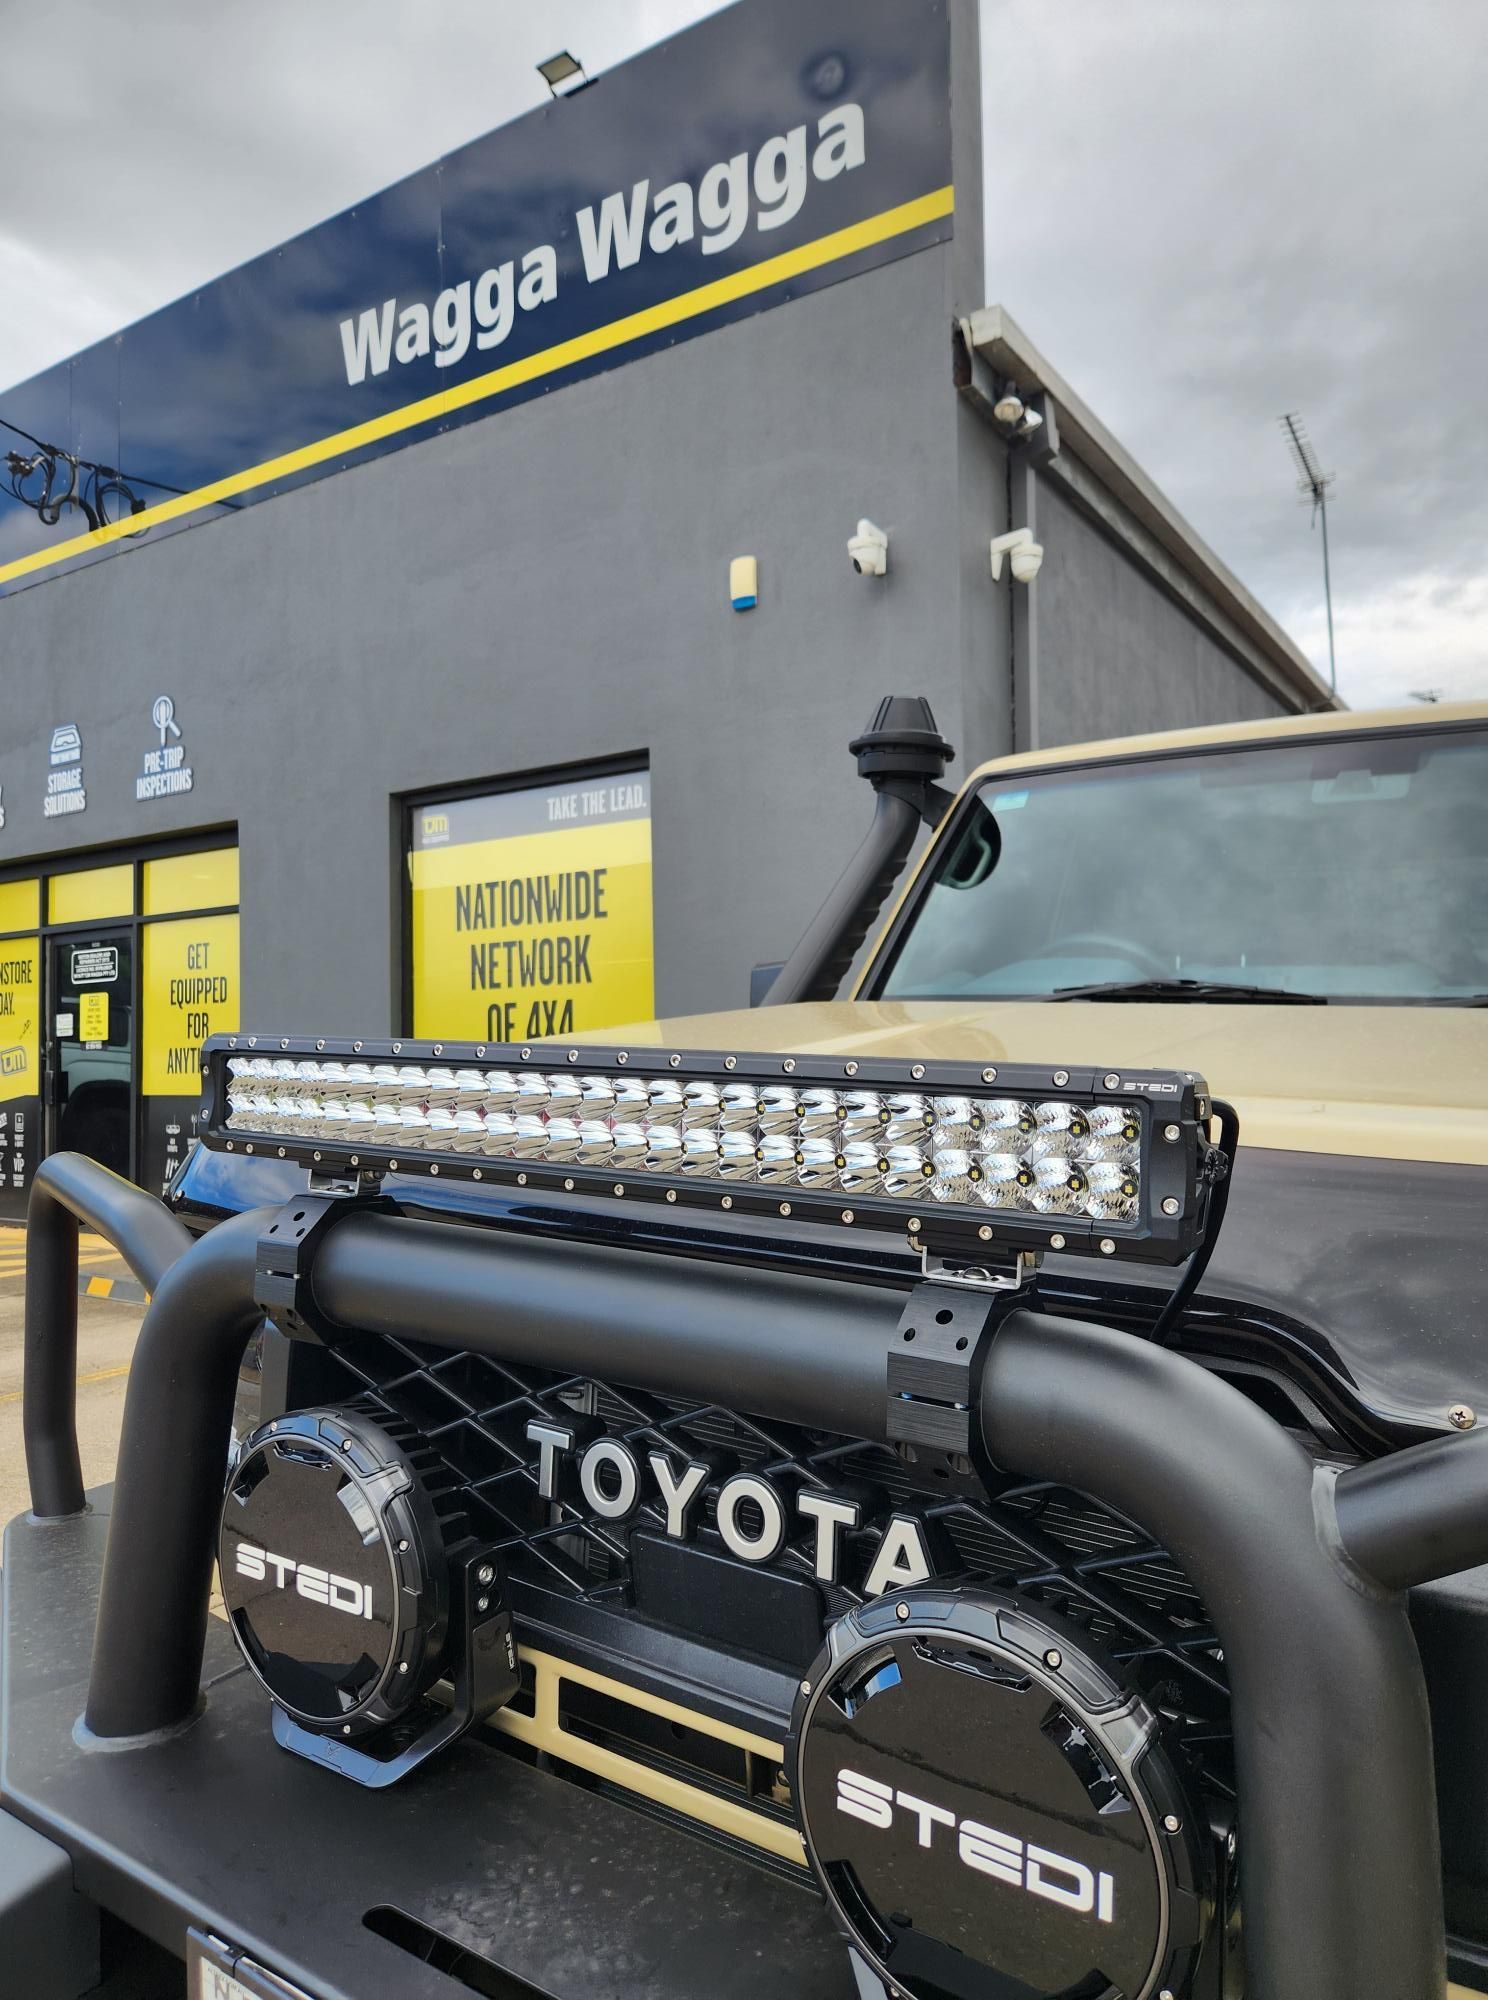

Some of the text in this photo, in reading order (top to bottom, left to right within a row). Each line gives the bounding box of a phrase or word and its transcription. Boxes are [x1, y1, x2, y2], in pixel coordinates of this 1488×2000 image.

[340, 103, 866, 386] Wagga Wagga
[144, 746, 184, 774] PRE-TRIP
[48, 768, 82, 793] STORAGE
[136, 768, 193, 799] INSPECTIONS
[44, 789, 86, 817] SOLUTIONS
[547, 785, 647, 821] TAKE THE LEAD.
[455, 868, 608, 932] NATIONWIDE
[187, 943, 210, 970] GET
[470, 934, 592, 991] NETWORK
[170, 976, 228, 1009] EQUIPPED
[187, 1012, 209, 1039] FOR
[487, 1002, 517, 1042] OF
[1122, 1082, 1178, 1093] STEDI
[526, 1422, 932, 1596] TOYOTA
[236, 1542, 373, 1620] STEDI
[836, 1768, 1114, 1923] STEDI
